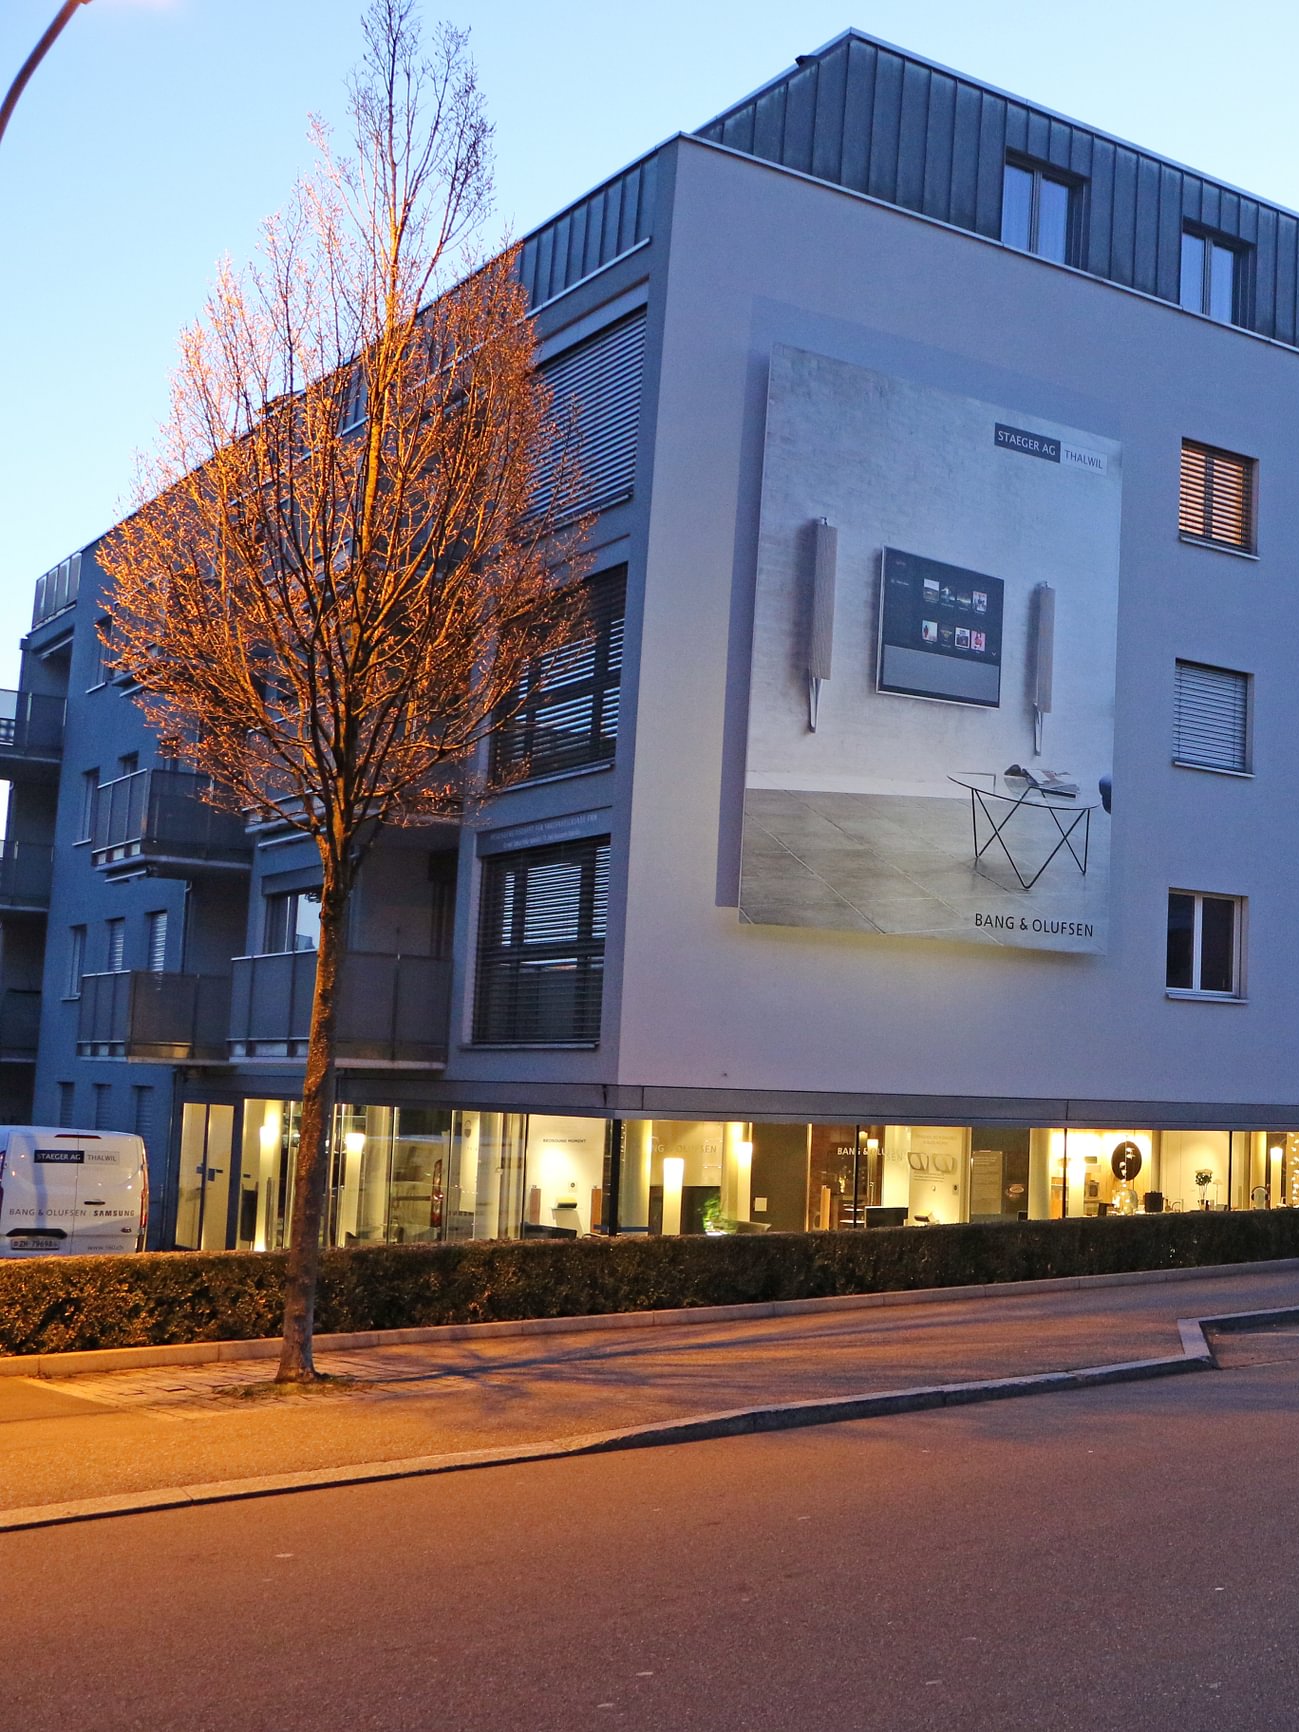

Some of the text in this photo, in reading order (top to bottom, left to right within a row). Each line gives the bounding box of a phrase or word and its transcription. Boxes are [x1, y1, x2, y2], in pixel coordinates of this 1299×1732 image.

[998, 431, 1056, 456] STAEGER AG
[1064, 449, 1103, 470] THALWIL
[975, 913, 1093, 937] BANG & OLUFSEN
[88, 1154, 117, 1162] THALWIL
[9, 1208, 35, 1217] BANG
[46, 1209, 87, 1217] OLUFSEN
